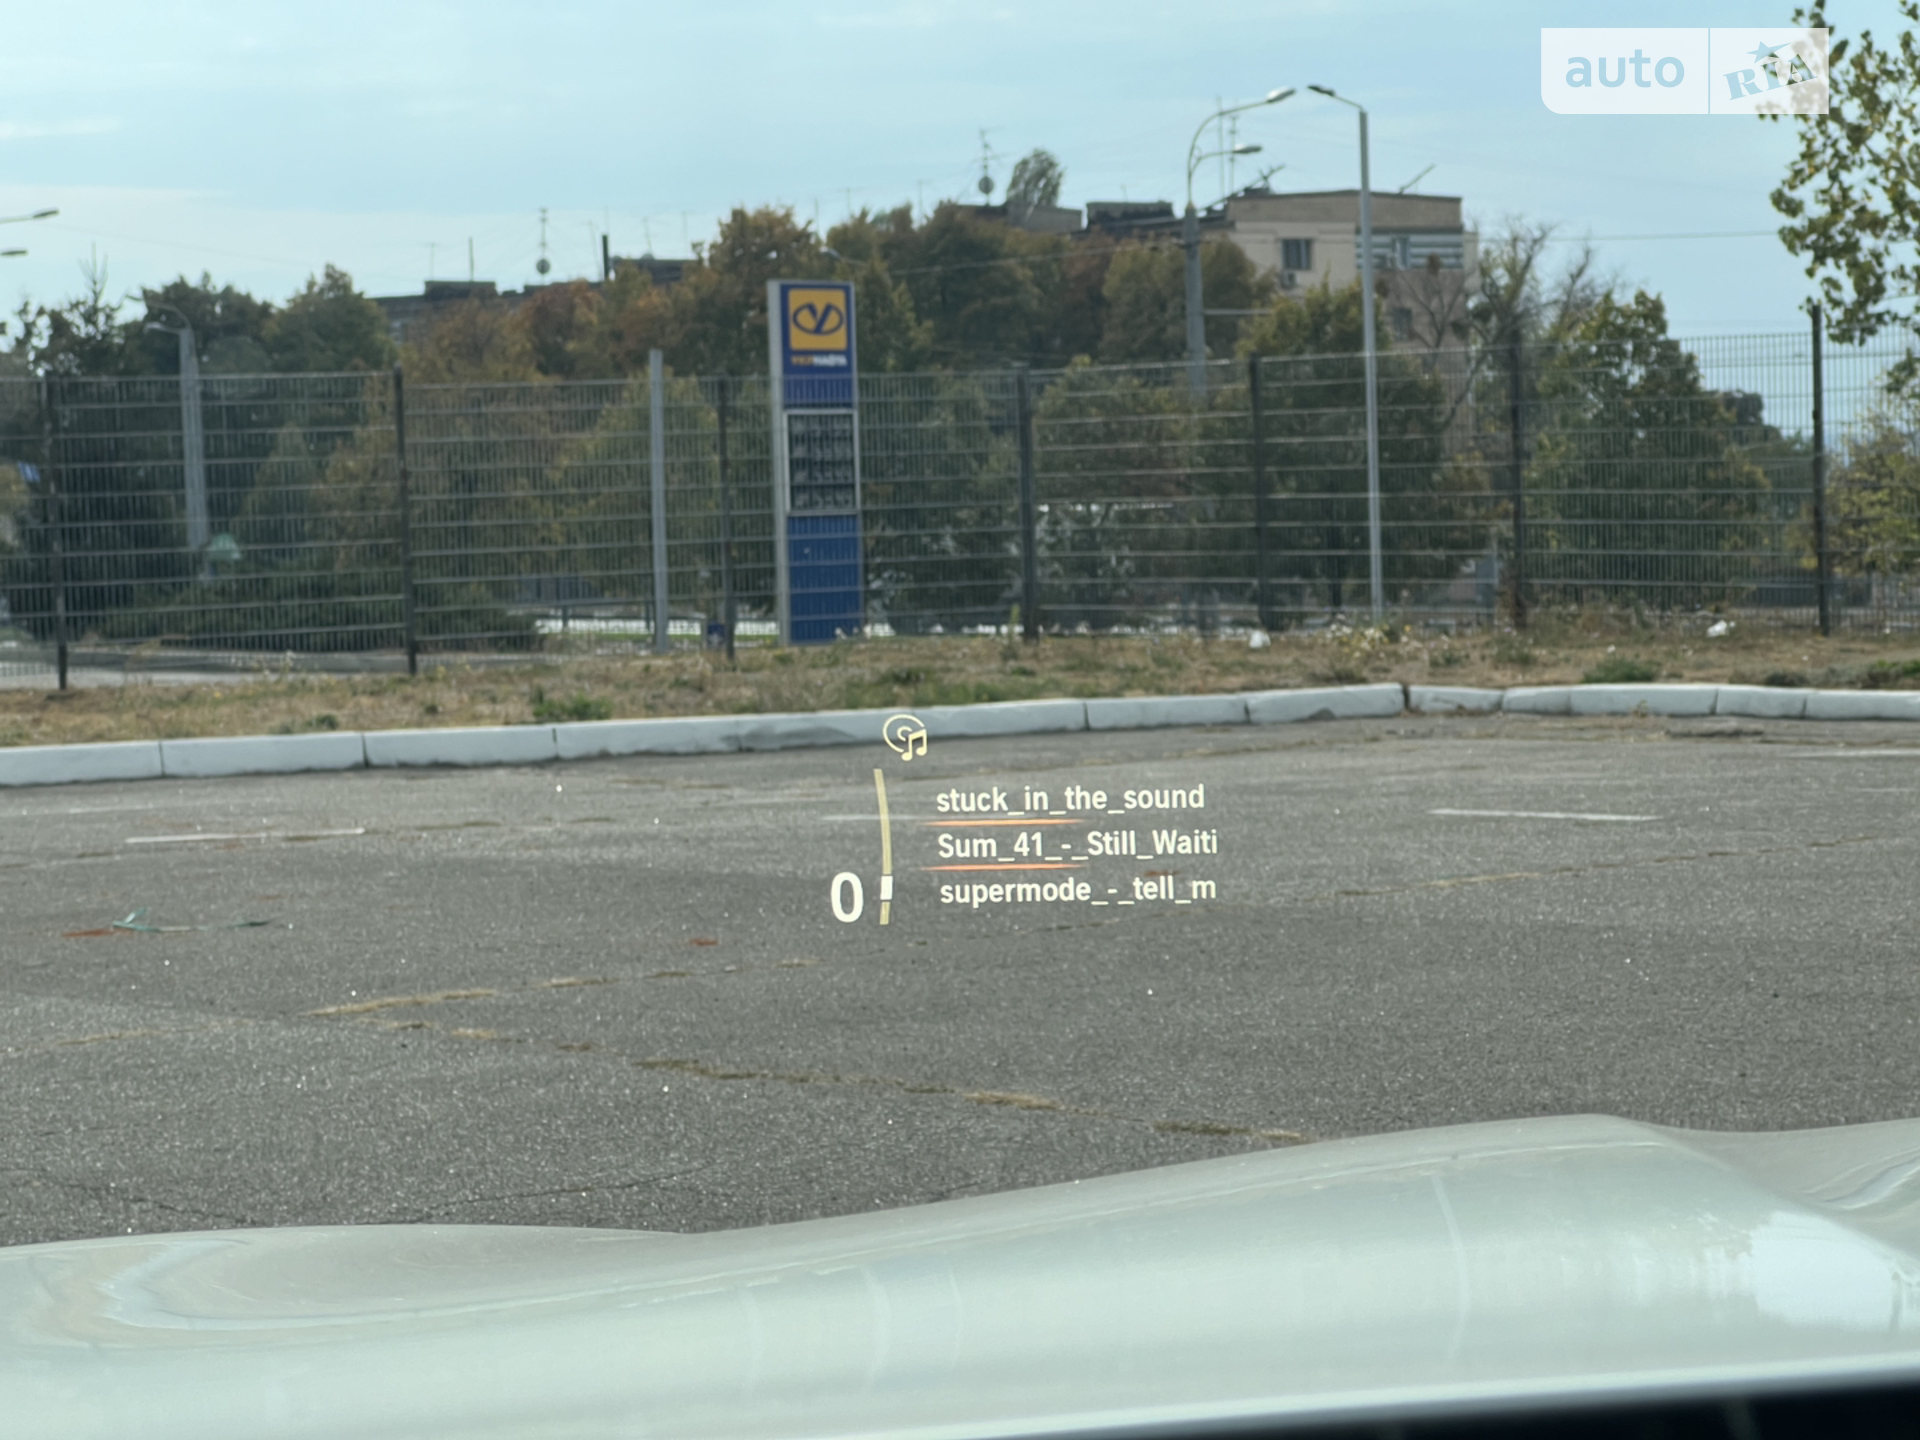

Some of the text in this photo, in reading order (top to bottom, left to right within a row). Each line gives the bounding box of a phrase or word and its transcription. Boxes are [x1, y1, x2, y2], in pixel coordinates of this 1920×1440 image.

[936, 783, 1205, 815] stuck_in_the_sound
[938, 829, 1218, 862] Sum_41_-_Still_Waiti
[831, 871, 864, 923] 0
[940, 875, 1217, 909] supermode_-_tell_m
